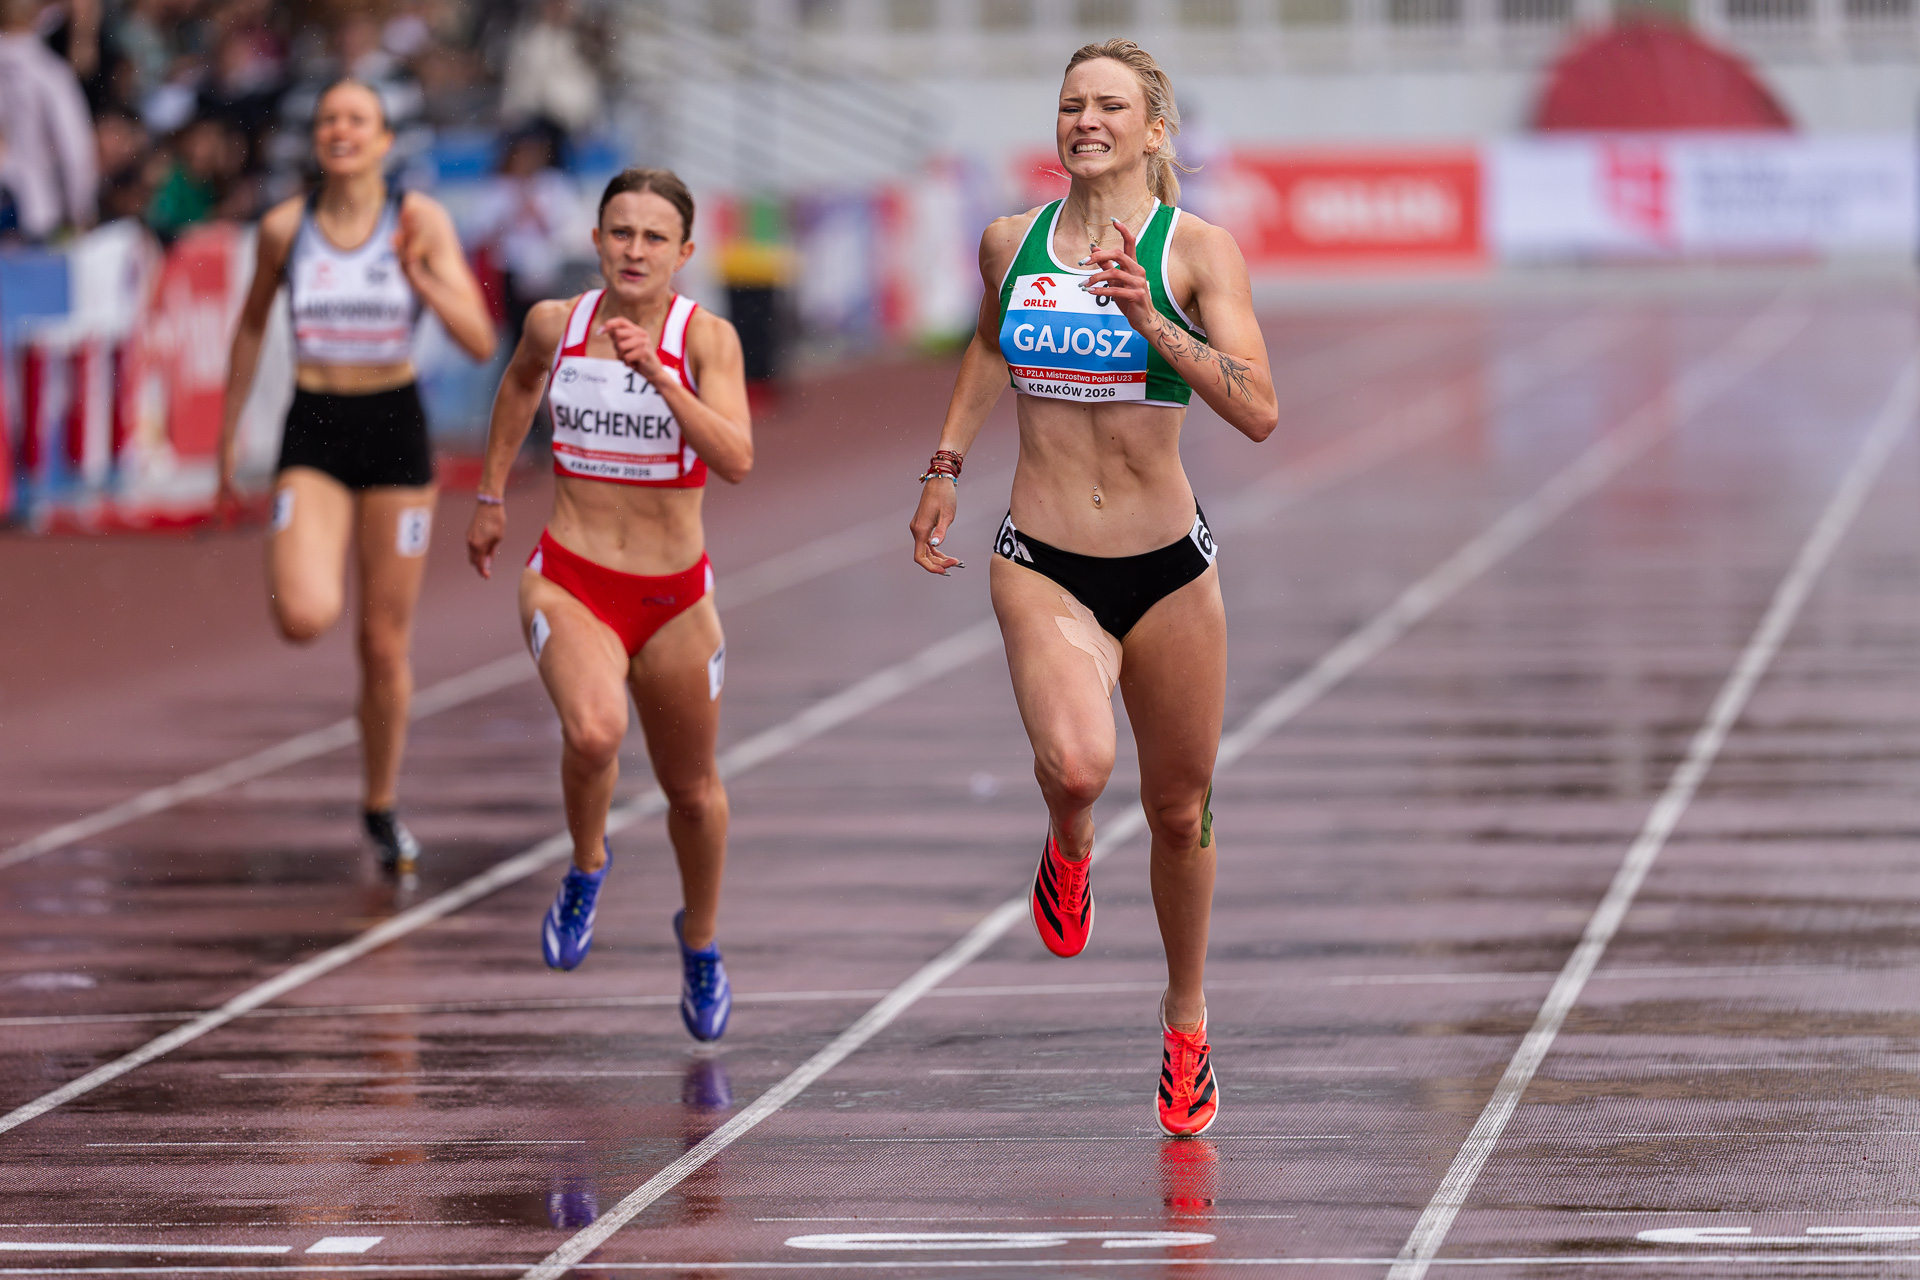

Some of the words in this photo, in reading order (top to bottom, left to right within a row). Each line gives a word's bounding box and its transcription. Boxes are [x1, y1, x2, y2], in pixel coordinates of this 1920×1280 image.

[1023, 298, 1057, 308] ORLEN
[1013, 323, 1133, 358] GAJOSZ
[1014, 368, 1025, 377] 43.
[1026, 369, 1045, 378] PZLA
[1046, 371, 1090, 382] Mistrzostwa
[1091, 374, 1116, 383] Polski
[1116, 374, 1133, 382] U23
[1028, 382, 1082, 397] KRAKÓW
[1084, 387, 1116, 398] 2026
[555, 404, 672, 440] SUCHENEK
[1000, 526, 1015, 560] 6
[1197, 524, 1213, 556] 6
